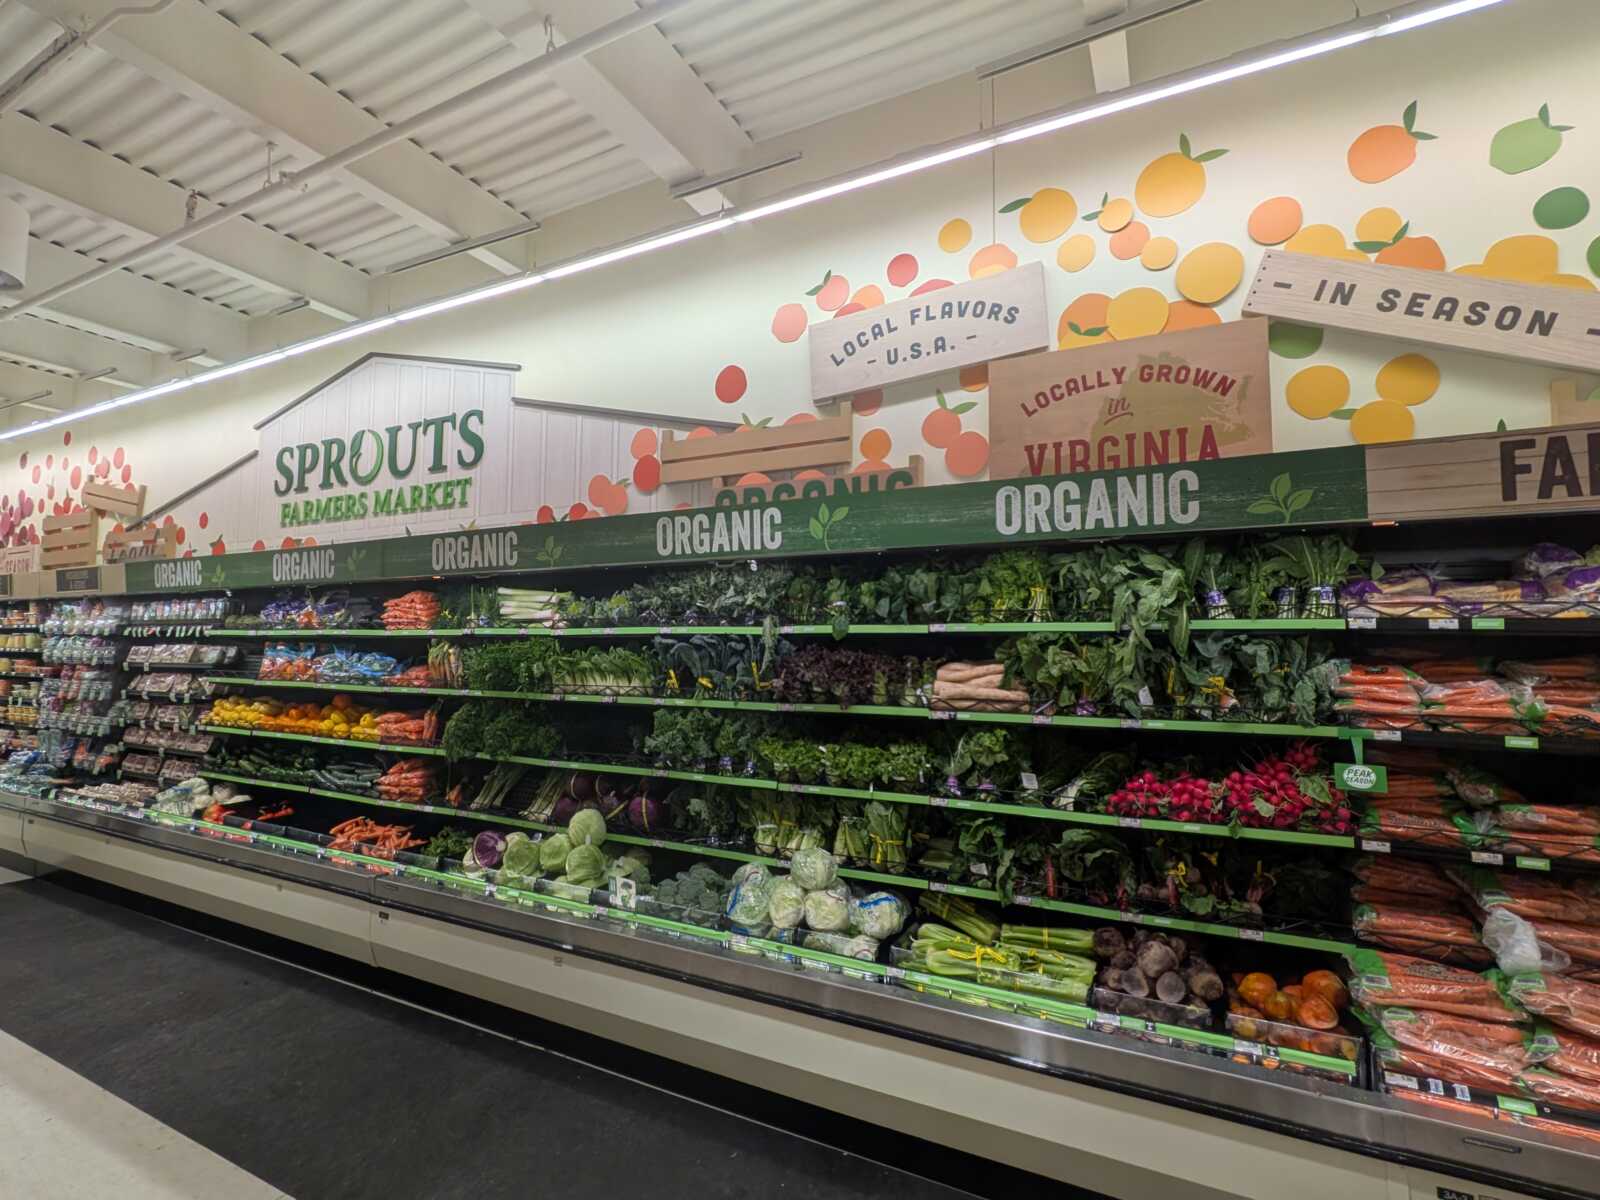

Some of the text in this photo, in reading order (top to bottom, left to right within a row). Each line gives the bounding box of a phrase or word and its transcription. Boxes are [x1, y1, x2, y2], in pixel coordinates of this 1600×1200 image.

[1313, 279, 1559, 337] IN SEASON
[830, 300, 1020, 367] LOCAL FLAVORS
[886, 336, 955, 365] U.S.A.
[1020, 364, 1237, 417] LOCALLY GROWN
[274, 409, 485, 497] SPROUTS
[1024, 424, 1220, 477] VIRGINIA
[280, 477, 472, 528] FARMERS MARKET
[995, 470, 1200, 535] ORGANIC
[431, 530, 518, 571] ORGANIC
[656, 507, 782, 556] ORGANIC
[153, 560, 202, 588] ORGANIC
[272, 549, 335, 582] ORGANIC
[1345, 776, 1375, 785] SEASON
[1347, 768, 1374, 778] PEAK
